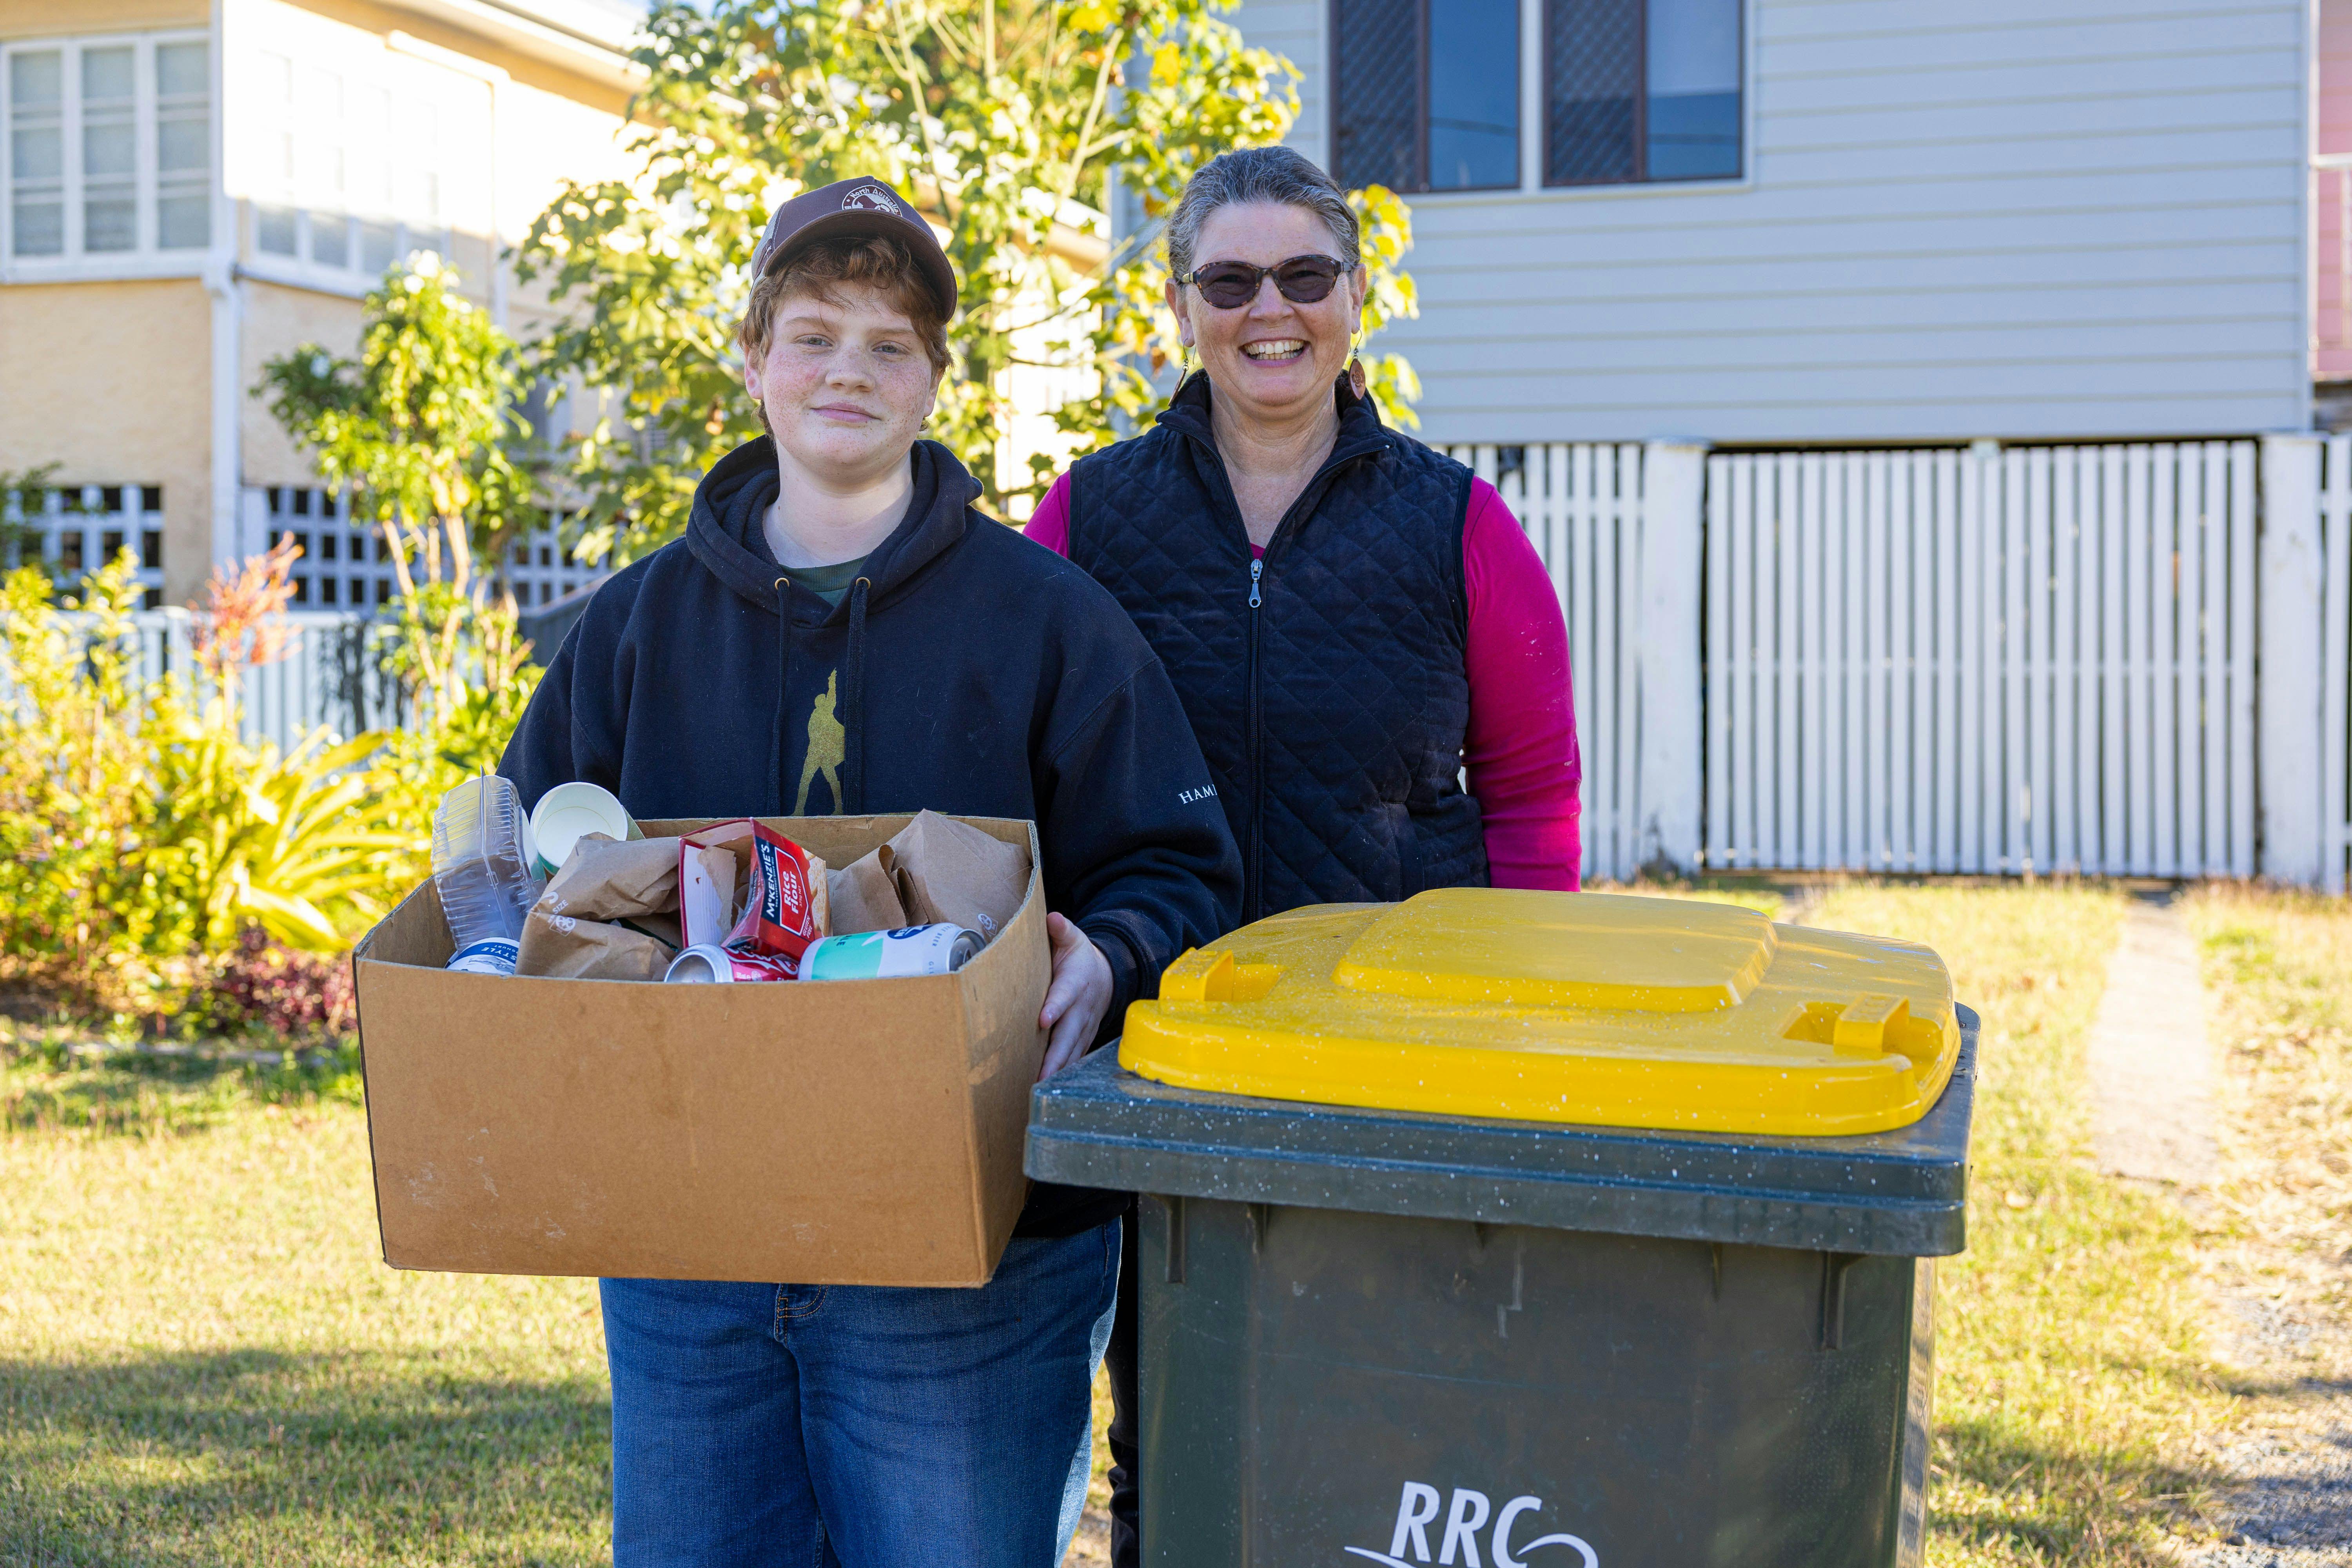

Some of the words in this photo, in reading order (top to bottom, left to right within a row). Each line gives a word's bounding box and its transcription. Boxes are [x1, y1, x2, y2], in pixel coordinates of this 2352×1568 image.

[849, 187, 870, 198] North
[783, 871, 791, 906] Rice
[790, 871, 799, 914] Flour
[552, 899, 569, 914] SIZE
[481, 947, 517, 960] STYLE
[1390, 1481, 1542, 1568] RRC
